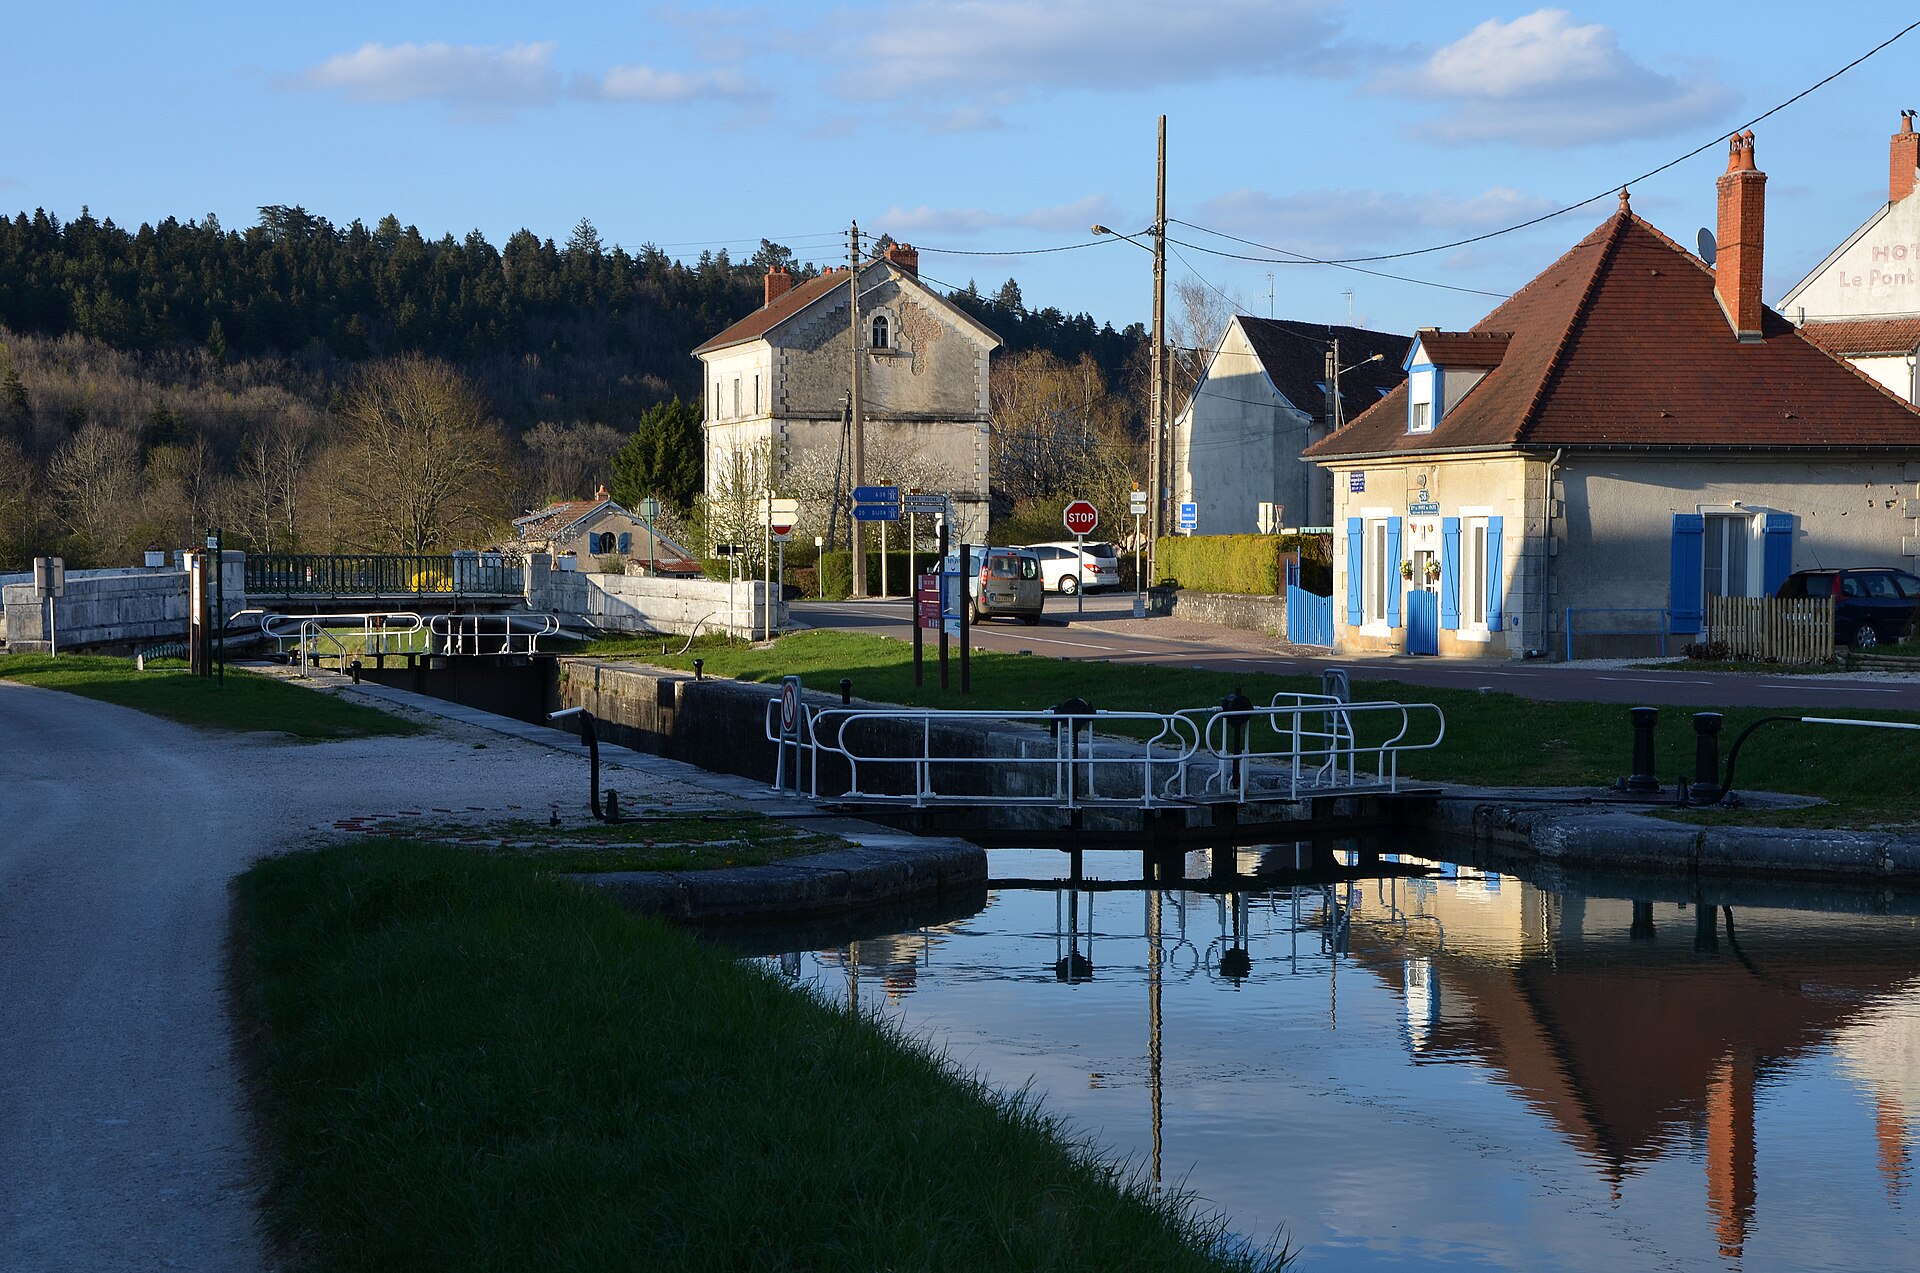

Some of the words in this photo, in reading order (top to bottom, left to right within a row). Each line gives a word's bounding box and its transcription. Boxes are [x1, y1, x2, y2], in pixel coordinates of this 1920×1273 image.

[1839, 271, 1863, 288] Le
[1869, 268, 1914, 287] Pont
[1068, 513, 1094, 522] STOP
